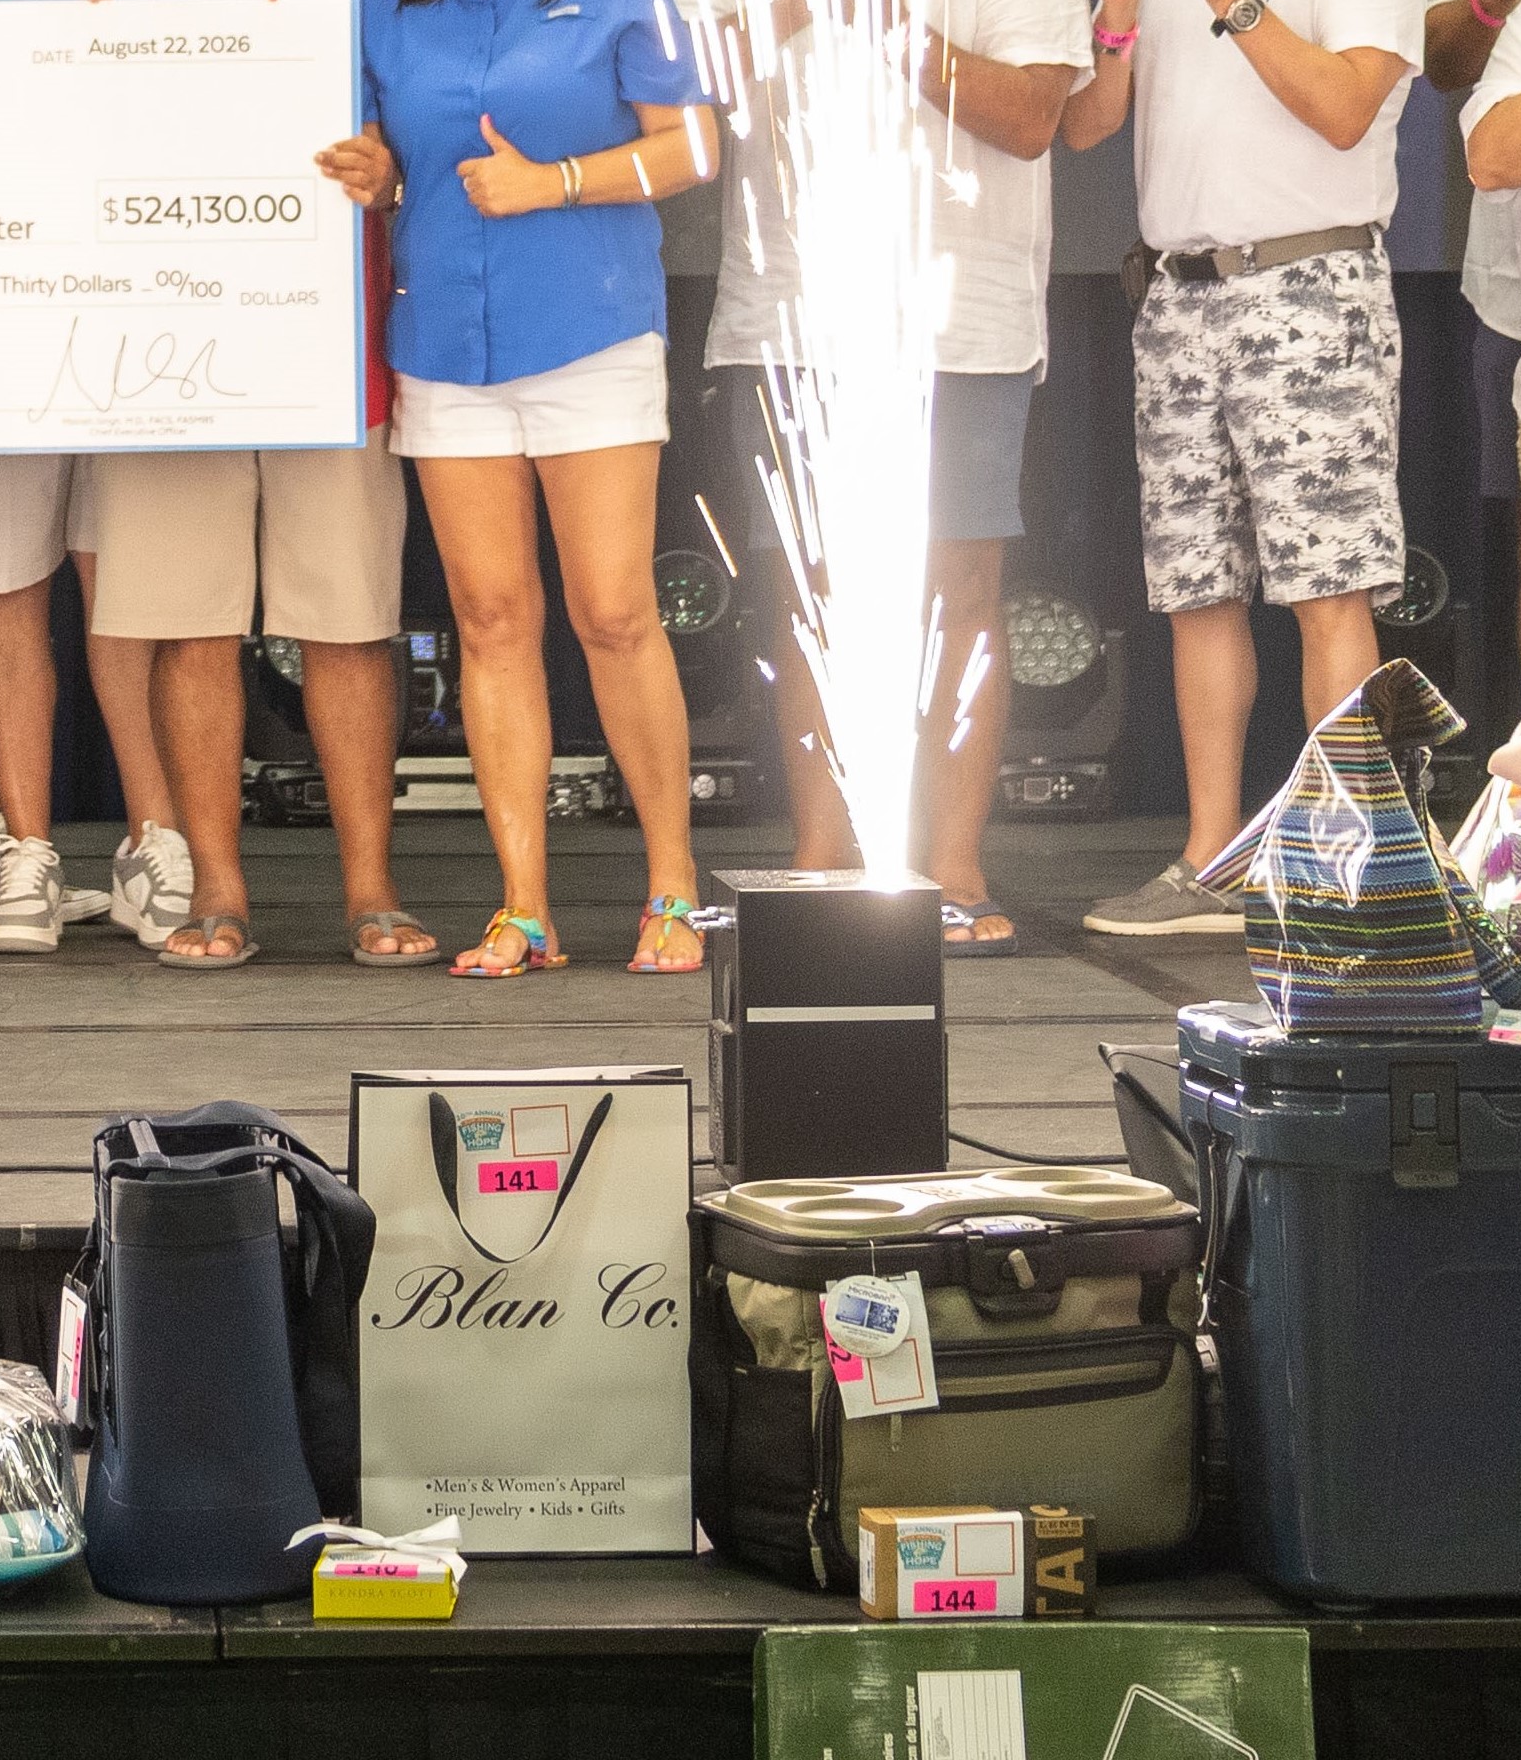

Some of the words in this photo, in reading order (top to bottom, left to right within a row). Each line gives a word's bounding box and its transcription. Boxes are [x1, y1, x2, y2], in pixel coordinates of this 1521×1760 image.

[32, 49, 74, 65] DATE
[88, 37, 157, 60] August
[163, 36, 192, 56] 22,
[198, 35, 251, 54] 2026
[63, 273, 133, 294] Dollars
[239, 289, 320, 307] DOLLARS
[494, 1169, 539, 1192] 141
[371, 1264, 566, 1330] Blan
[597, 1262, 680, 1329] Co.
[481, 1478, 495, 1493] &
[498, 1477, 567, 1493] Women's
[569, 1476, 626, 1495] Apparel
[434, 1502, 466, 1517] Fine
[467, 1501, 523, 1520] Jewelry
[540, 1501, 573, 1517] Kids
[590, 1500, 626, 1517] Gifts
[930, 1589, 977, 1612] 144
